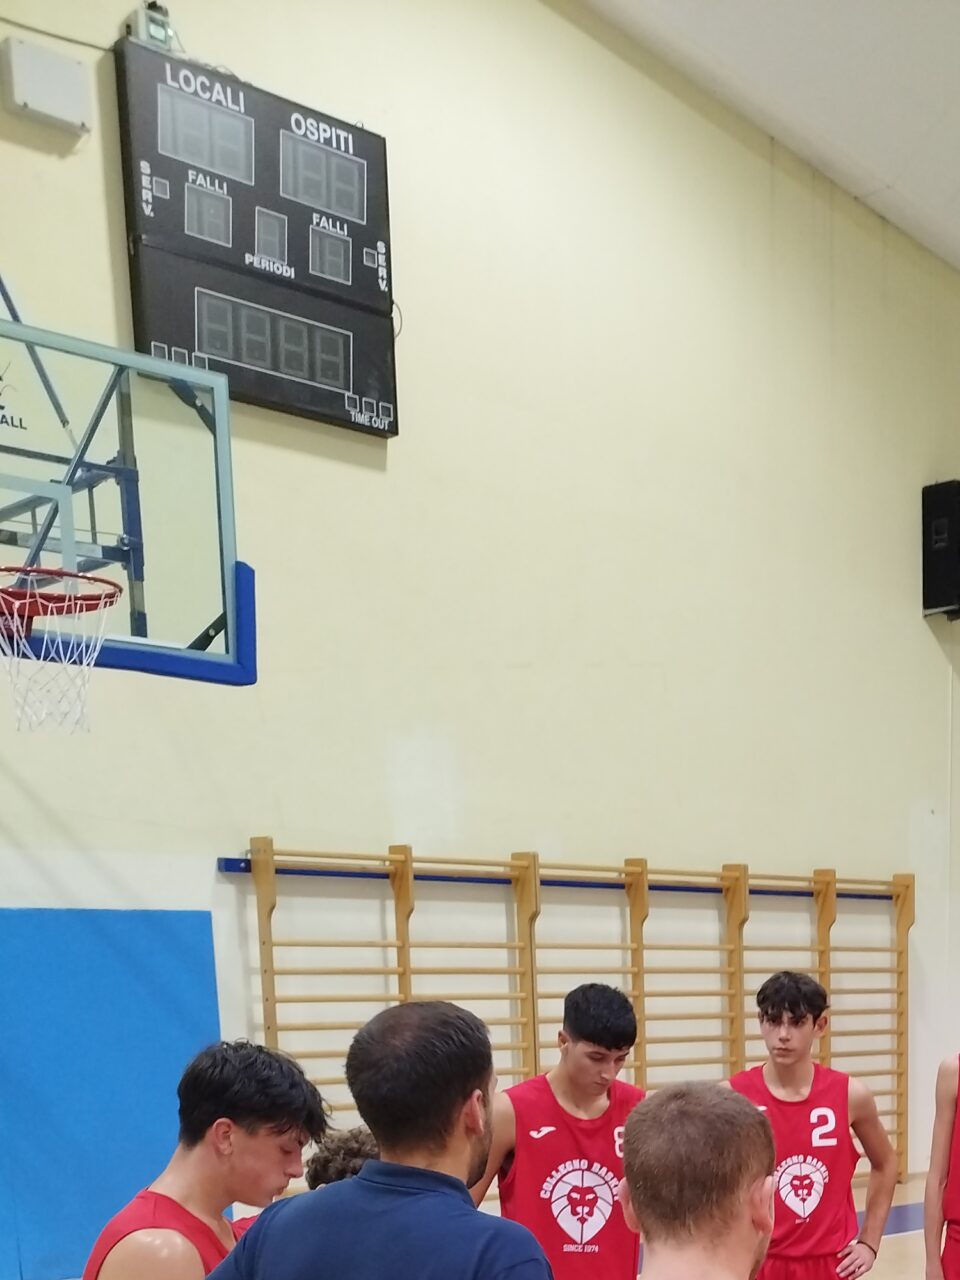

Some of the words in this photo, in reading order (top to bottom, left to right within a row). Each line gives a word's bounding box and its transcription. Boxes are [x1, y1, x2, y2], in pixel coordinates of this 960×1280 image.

[165, 62, 245, 113] LOCALI
[290, 112, 354, 155] OSPITI
[188, 169, 228, 195] FALLI
[312, 213, 348, 236] FALLI
[244, 252, 296, 279] PERIODI
[350, 411, 370, 426] TIME
[371, 416, 389, 431] OUT
[809, 1107, 838, 1147] 2
